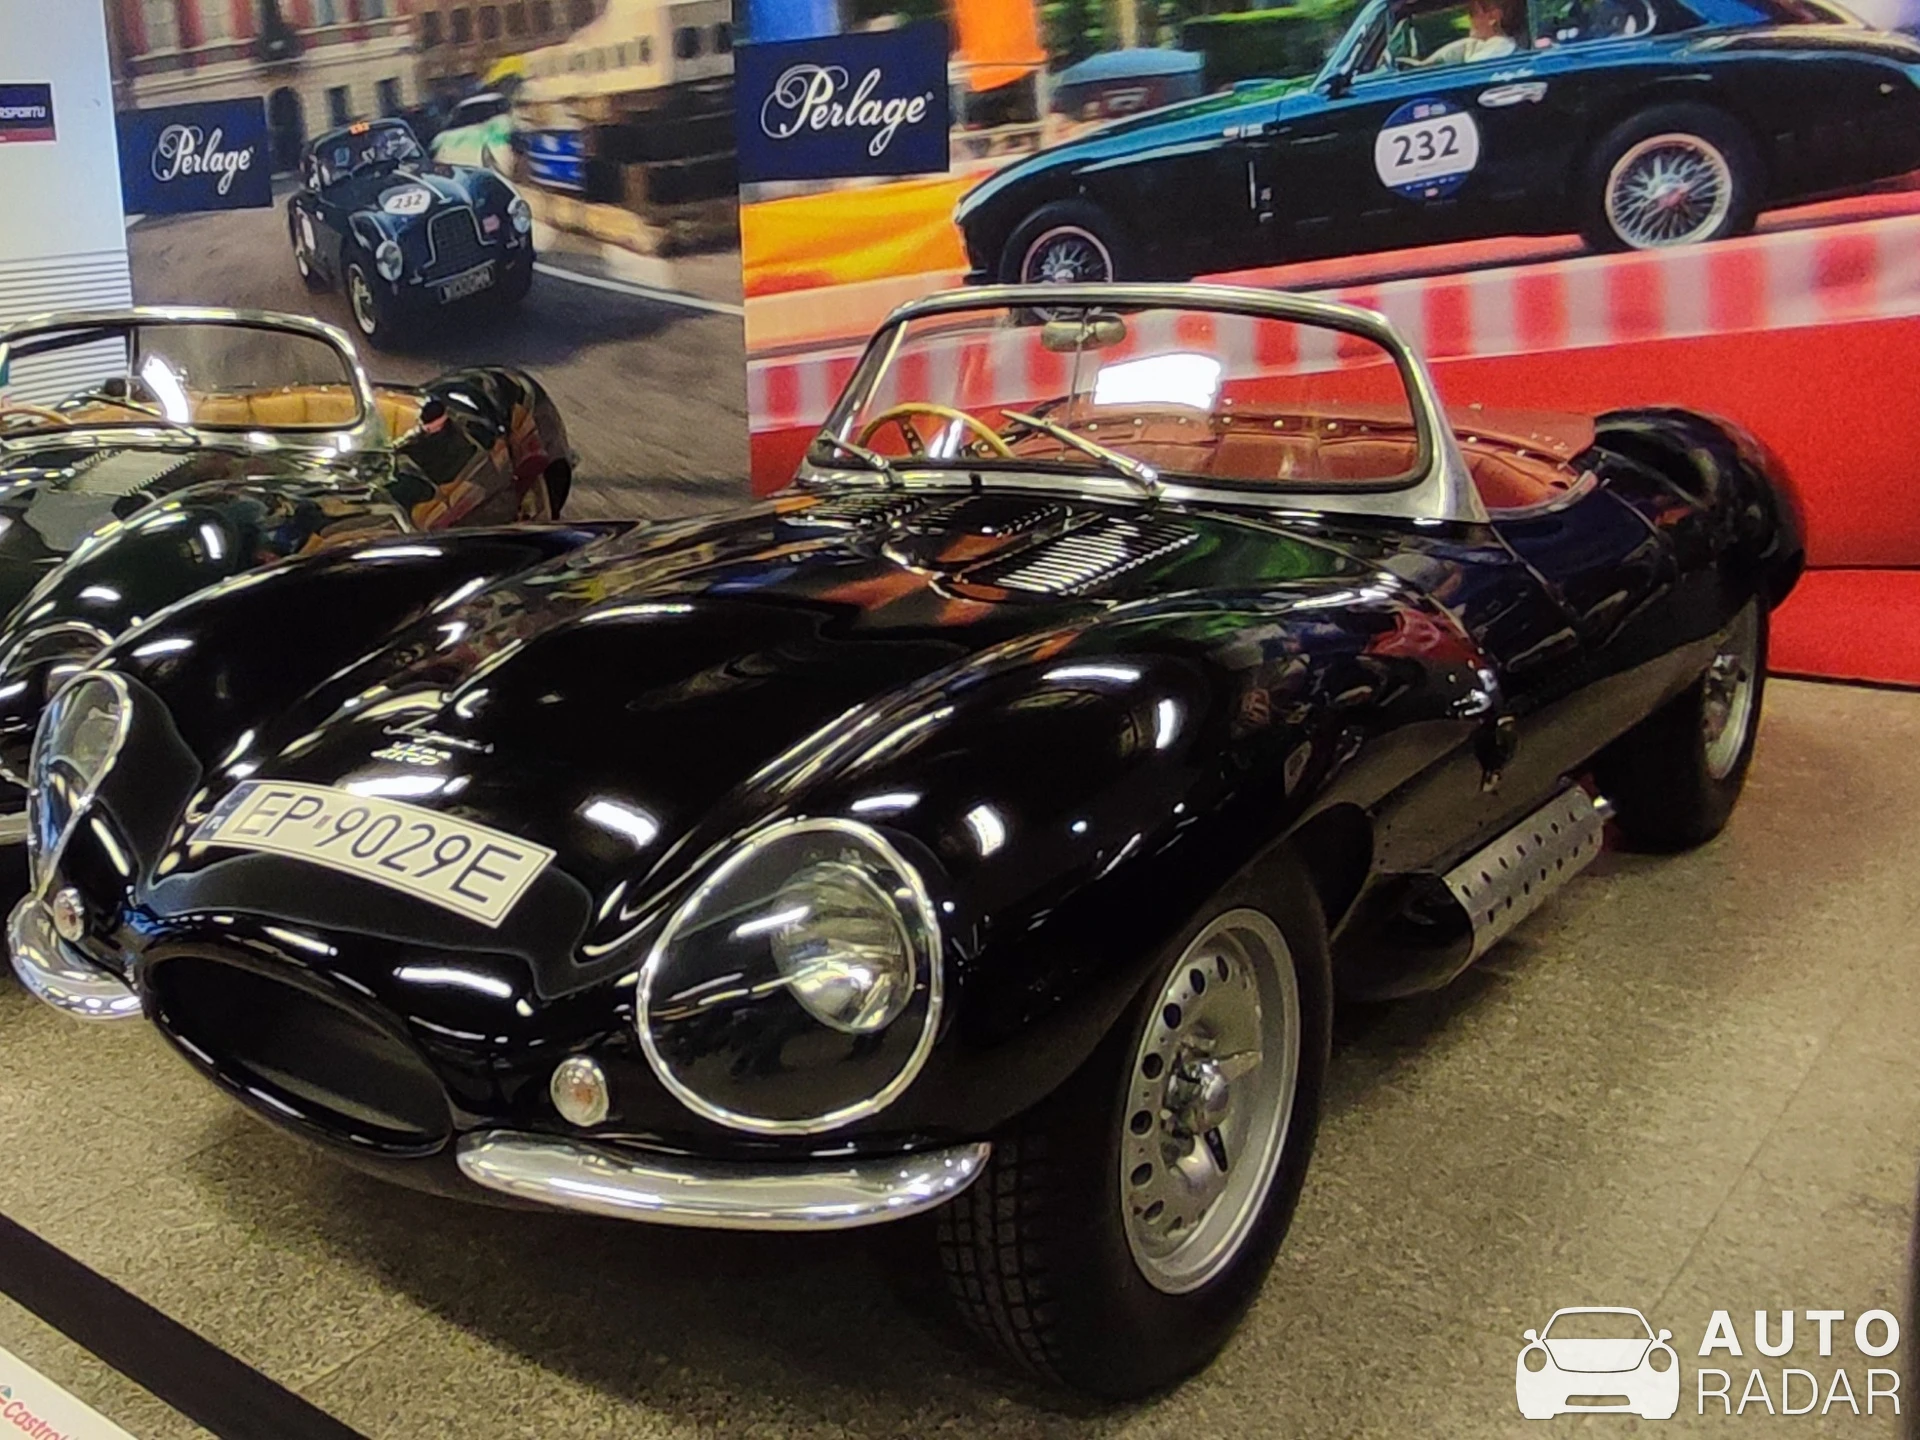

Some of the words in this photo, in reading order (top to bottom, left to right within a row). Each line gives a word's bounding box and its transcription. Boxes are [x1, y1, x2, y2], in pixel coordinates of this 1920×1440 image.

[761, 64, 928, 156] Perlage
[151, 124, 253, 195] Perlage
[1393, 124, 1459, 167] 232
[393, 193, 423, 209] 232
[3, 1401, 70, 1440] Castro
